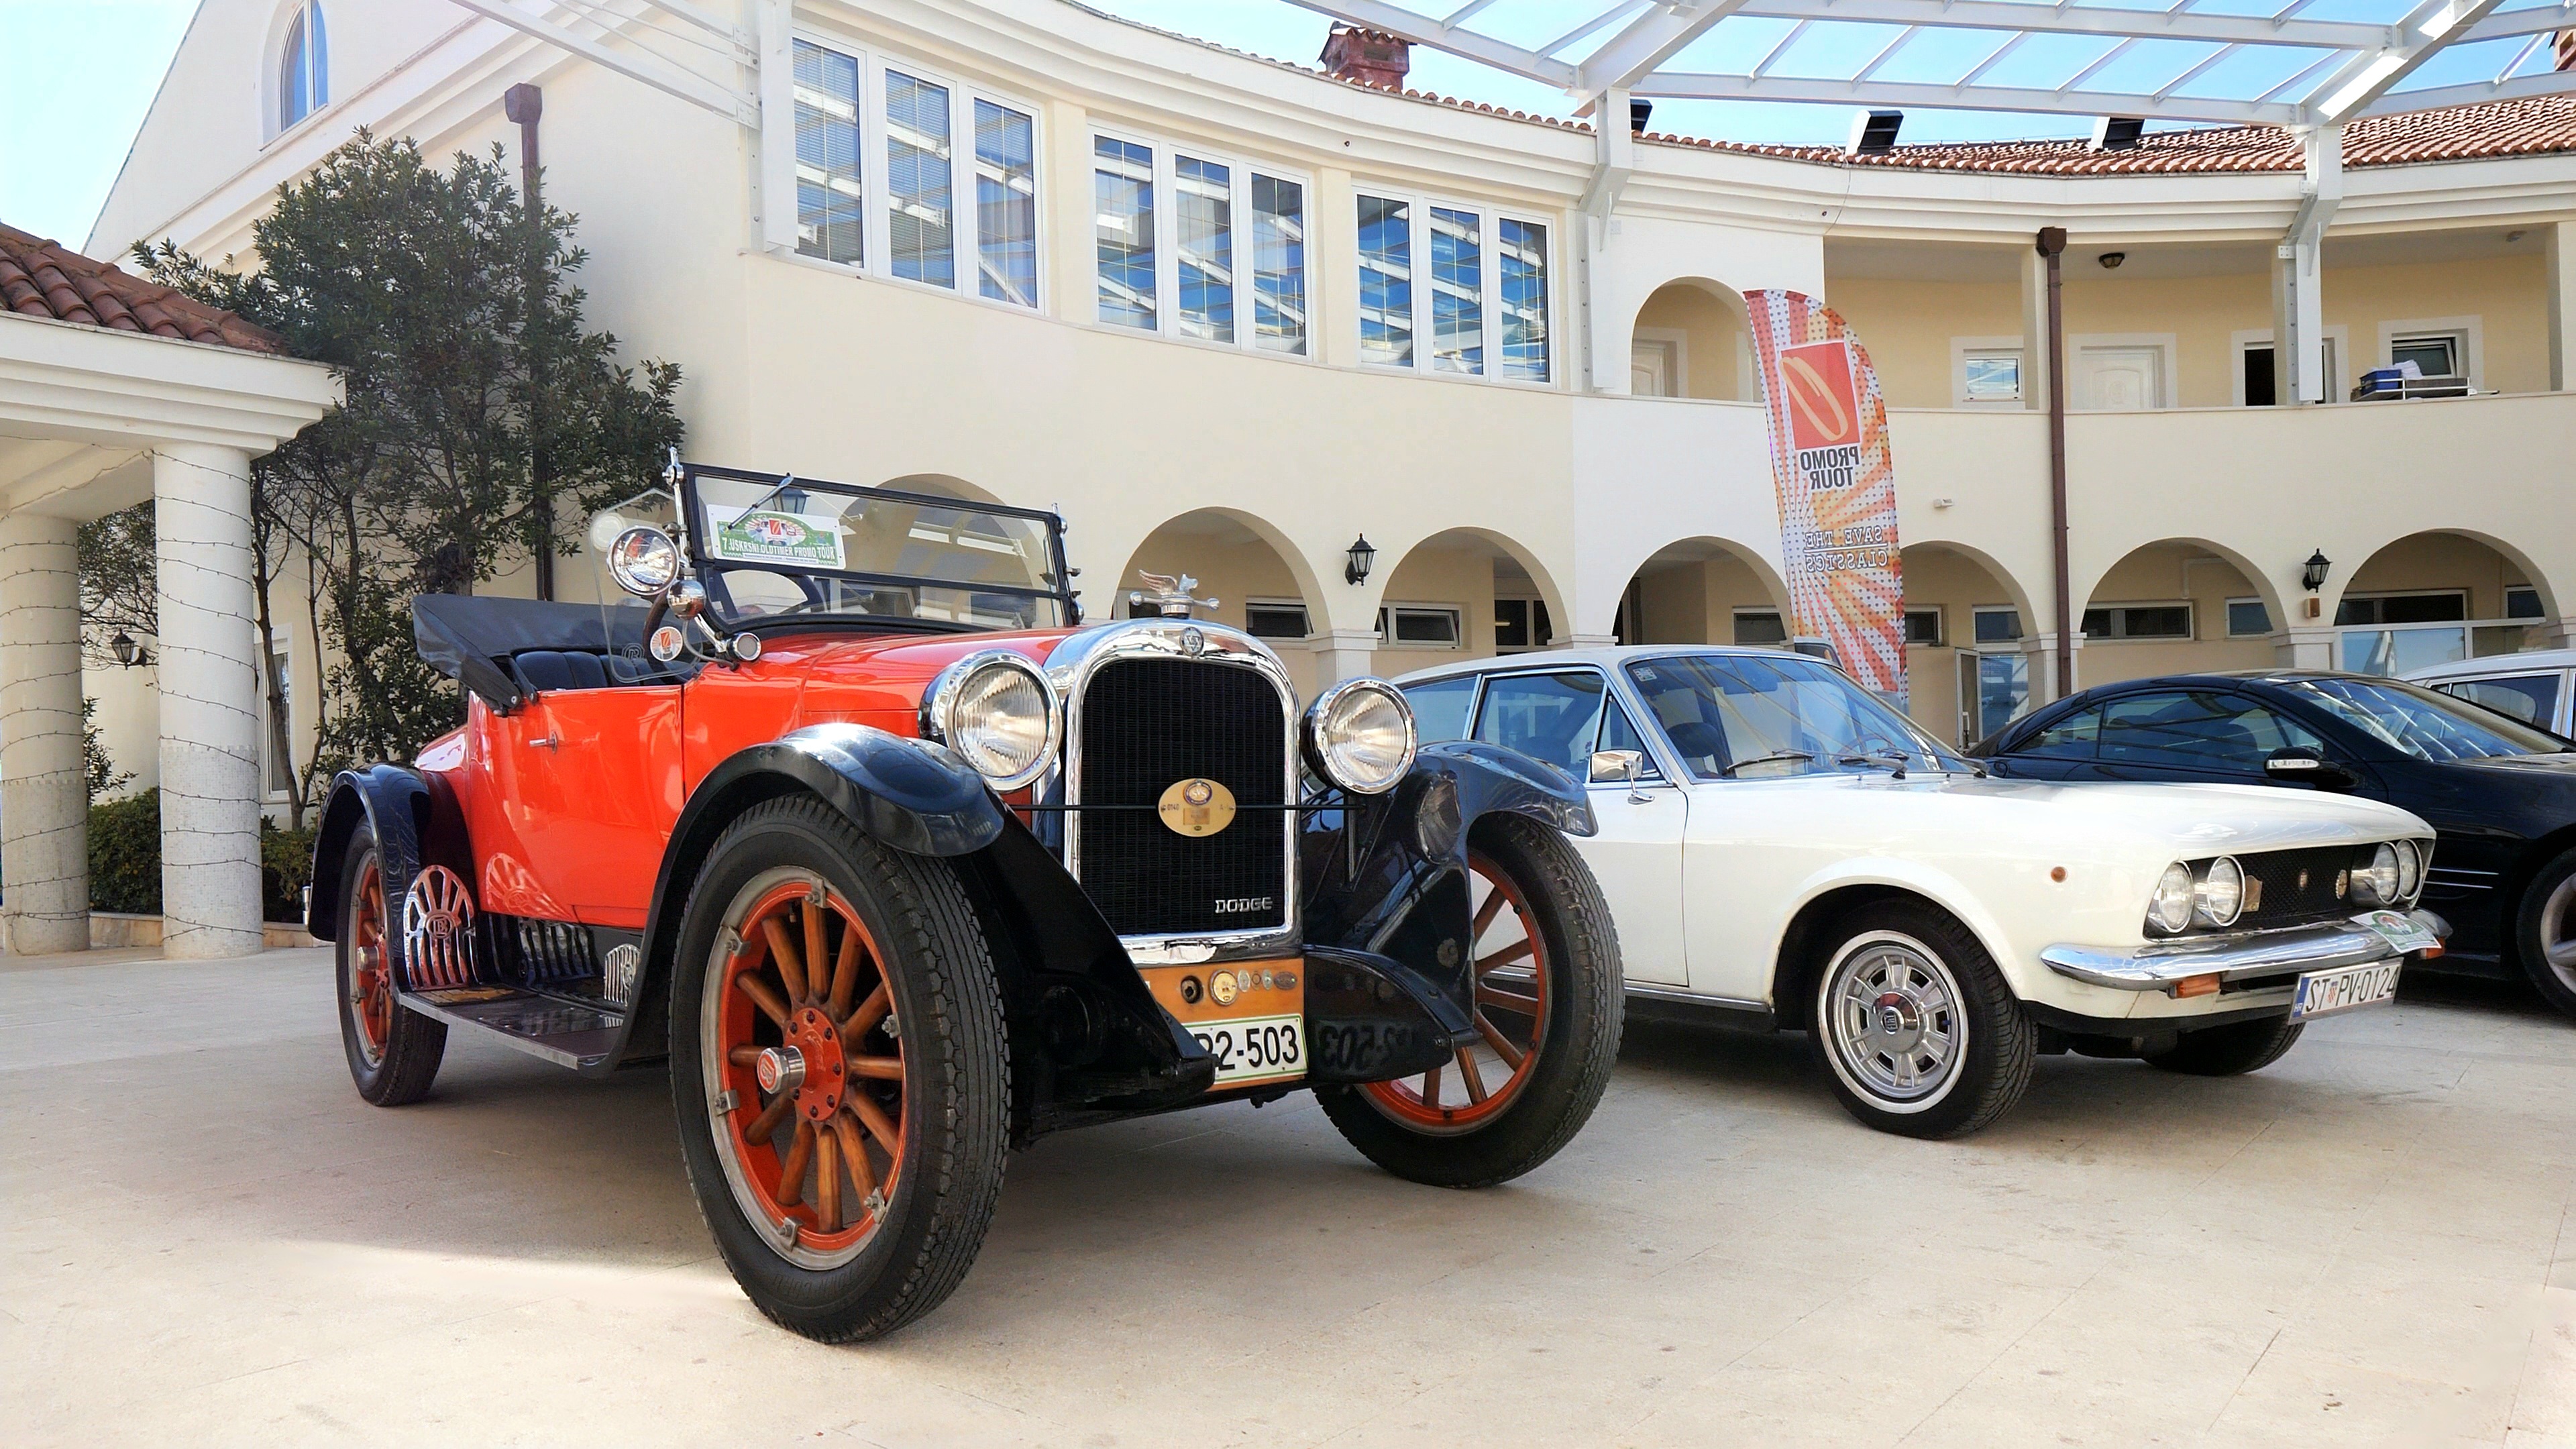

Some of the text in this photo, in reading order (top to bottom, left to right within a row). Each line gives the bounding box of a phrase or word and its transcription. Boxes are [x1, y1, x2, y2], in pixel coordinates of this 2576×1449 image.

[761, 544, 793, 556] OLDTIMER
[794, 546, 817, 558] PROMO
[817, 545, 836, 560] TOUR
[1215, 897, 1273, 913] DODGE
[2306, 978, 2331, 1012] ST
